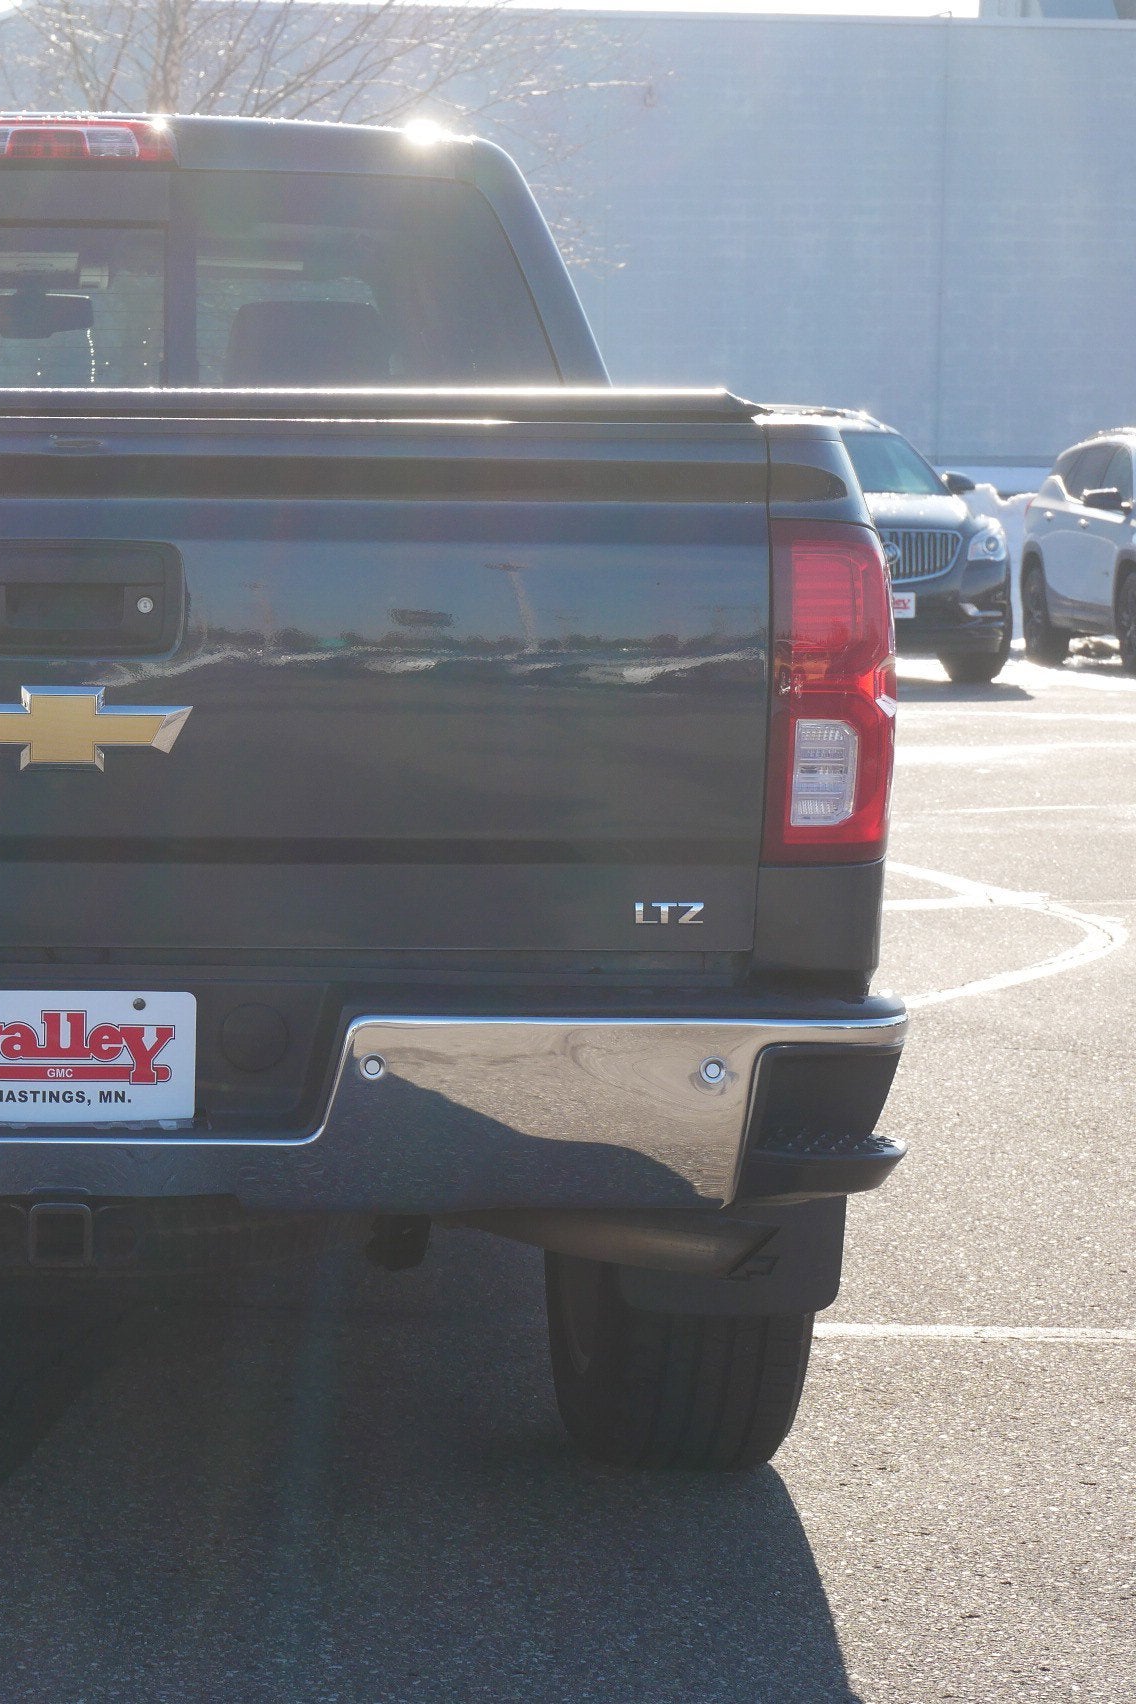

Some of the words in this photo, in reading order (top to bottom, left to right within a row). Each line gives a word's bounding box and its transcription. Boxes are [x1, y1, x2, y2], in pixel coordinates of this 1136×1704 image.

[634, 902, 705, 924] LTZ
[46, 1067, 74, 1079] GMC
[98, 1090, 132, 1104] MN.
